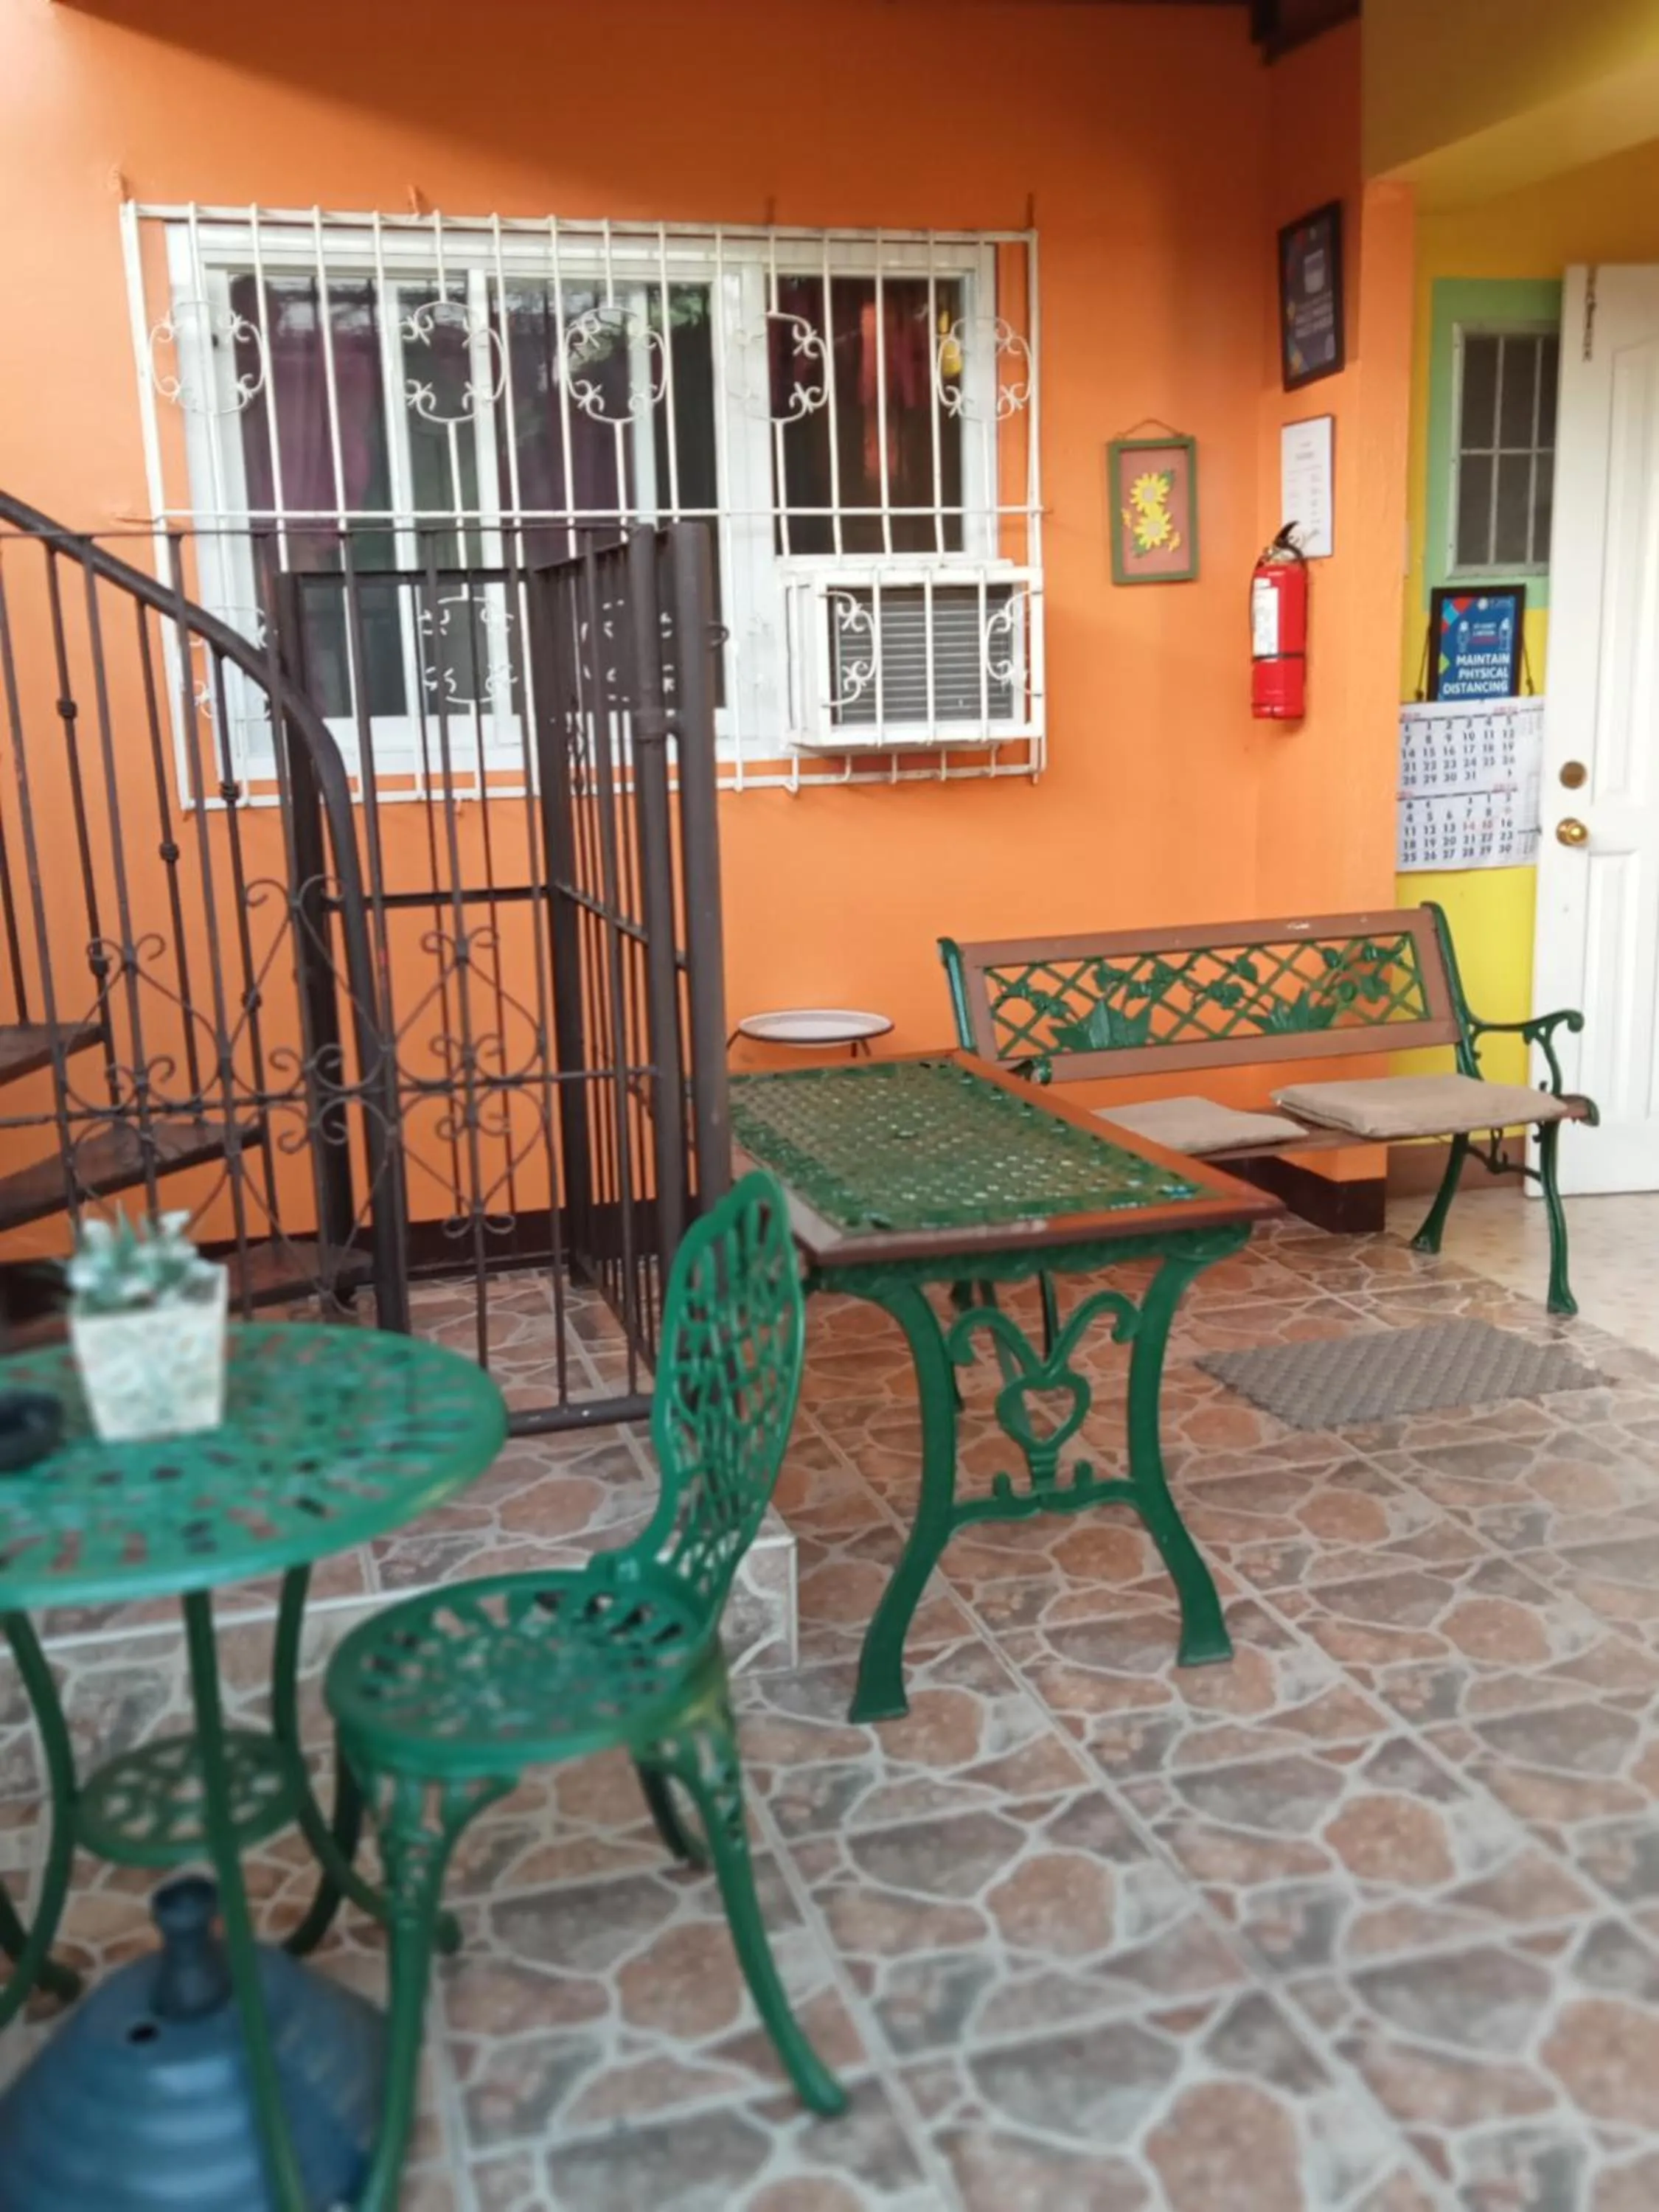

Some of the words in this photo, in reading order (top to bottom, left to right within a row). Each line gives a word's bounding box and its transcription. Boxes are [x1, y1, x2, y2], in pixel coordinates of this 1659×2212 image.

[1456, 654, 1510, 667] MAINTAIN
[1458, 667, 1509, 678] PHYSICAL
[1443, 681, 1509, 695] DISTANCING
[1463, 731, 1475, 740] 10
[1483, 730, 1495, 739] 11
[1503, 729, 1514, 738] 12
[1402, 748, 1416, 759] 14
[1423, 748, 1436, 757] 15
[1443, 746, 1455, 755] 16
[1464, 745, 1475, 754] 17
[1483, 743, 1495, 753] 18
[1503, 742, 1514, 751] 19
[1403, 762, 1416, 772] 21
[1423, 761, 1436, 771] 22
[1444, 760, 1457, 769] 23
[1464, 758, 1477, 768] 24
[1484, 757, 1495, 766] 25
[1503, 756, 1515, 765] 26
[1403, 776, 1416, 785] 28
[1424, 774, 1437, 785] 29
[1444, 773, 1457, 782] 30
[1464, 771, 1476, 781] 31
[1405, 827, 1416, 836] 11
[1425, 825, 1436, 835] 12
[1444, 824, 1456, 832] 13
[1500, 818, 1513, 827] 16
[1404, 840, 1416, 850] 18
[1425, 838, 1436, 848] 19
[1443, 837, 1457, 846] 20
[1464, 835, 1475, 844] 21
[1481, 833, 1492, 843] 22
[1500, 832, 1513, 841] 23
[1403, 852, 1416, 863] 25
[1424, 852, 1436, 861] 26
[1443, 849, 1455, 859] 27
[1463, 848, 1475, 858] 28
[1481, 846, 1492, 855] 29
[1499, 844, 1512, 853] 30
